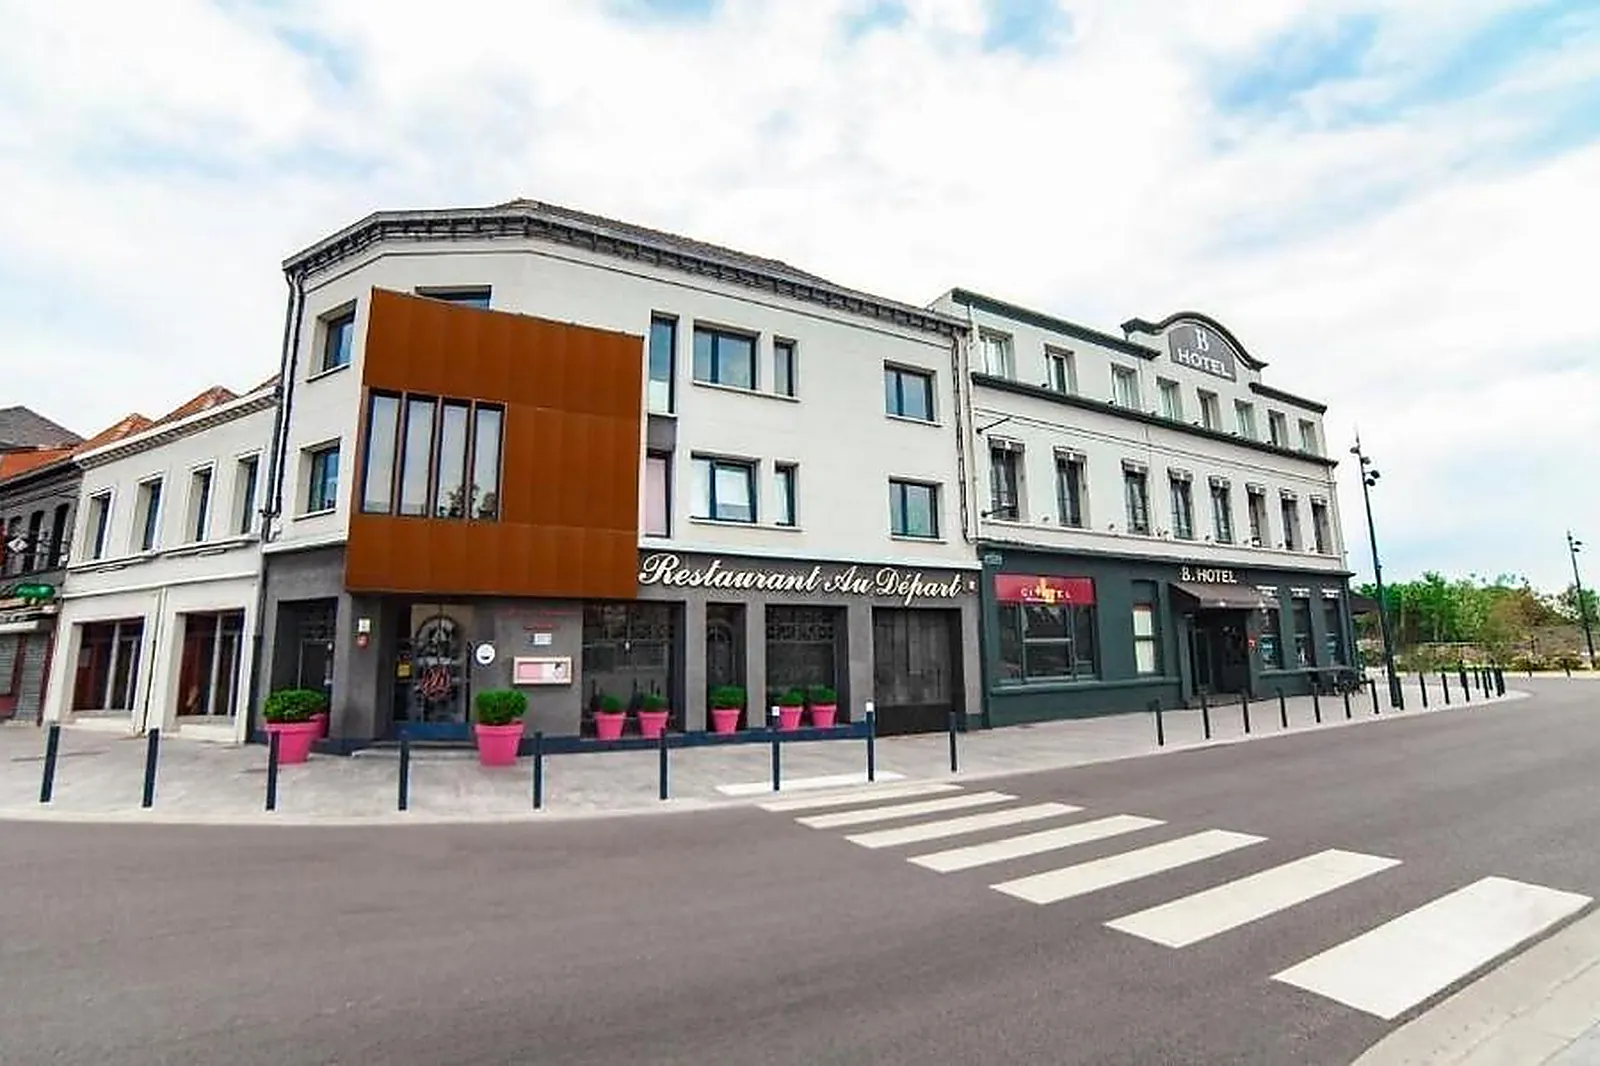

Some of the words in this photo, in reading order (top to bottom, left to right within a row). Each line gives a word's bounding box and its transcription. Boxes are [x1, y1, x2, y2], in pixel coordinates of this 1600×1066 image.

[1177, 348, 1232, 377] HOTEL
[638, 553, 823, 592] Restaurant
[824, 565, 873, 595] Au
[876, 567, 962, 606] Départ
[1181, 566, 1195, 581] B.
[1197, 568, 1237, 584] HOTEL
